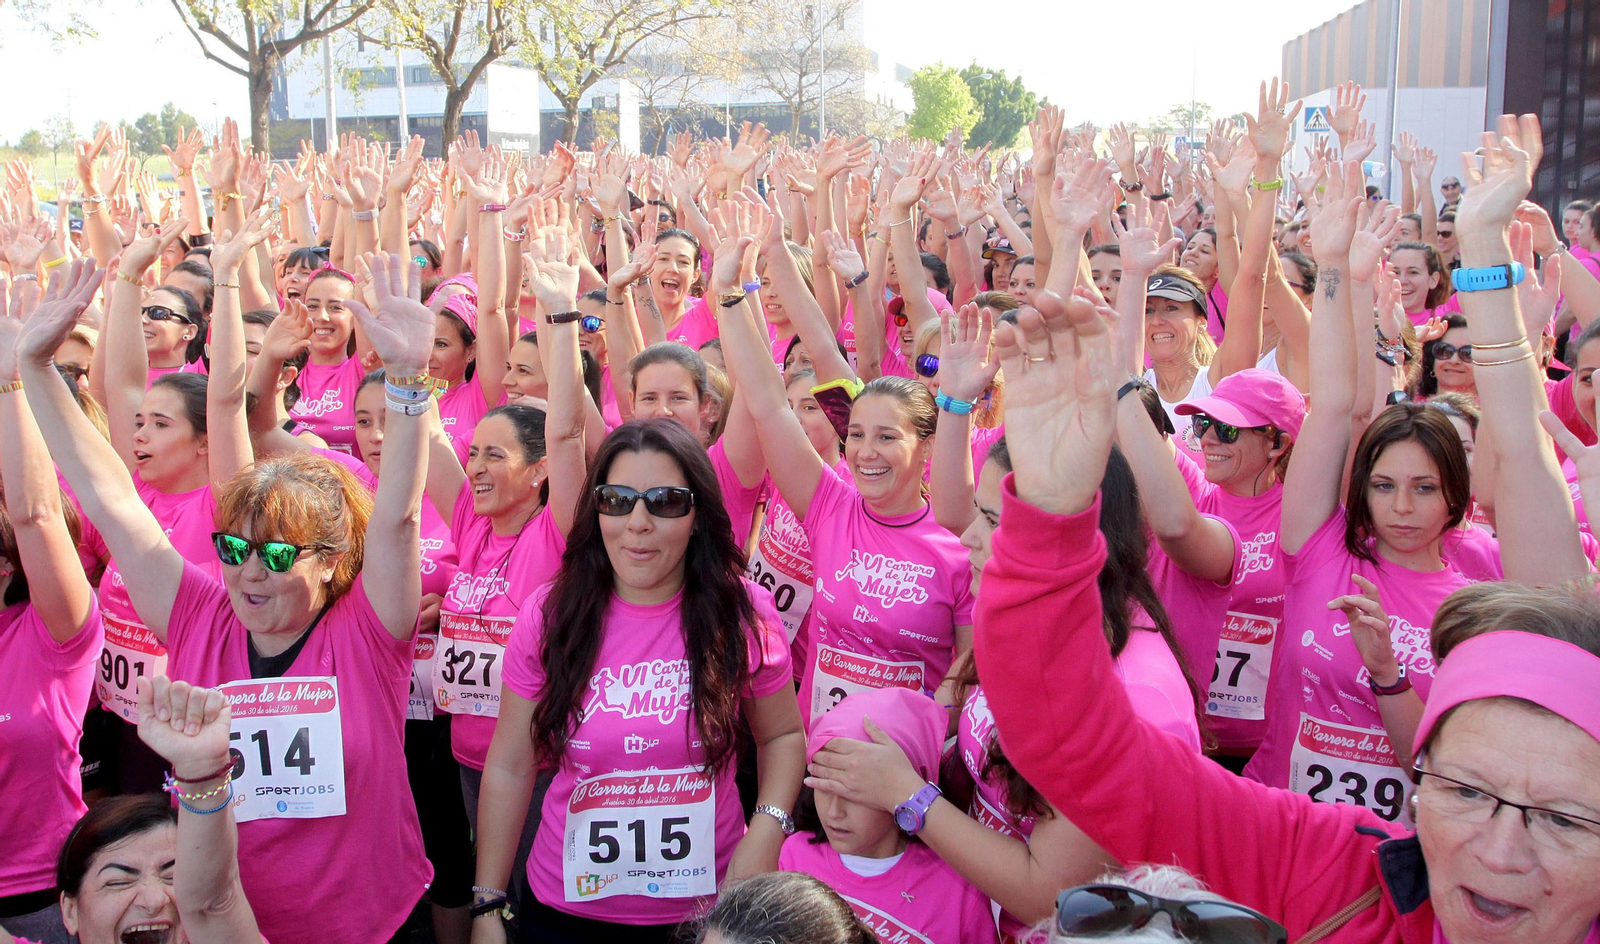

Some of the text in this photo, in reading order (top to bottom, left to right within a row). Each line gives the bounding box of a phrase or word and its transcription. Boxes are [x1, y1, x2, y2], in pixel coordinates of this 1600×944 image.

[778, 553, 788, 565] de
[787, 558, 797, 569] la
[864, 553, 933, 575] VI Carrera
[885, 569, 915, 583] de la
[861, 575, 926, 607] Mujer
[470, 619, 480, 631] de
[1228, 616, 1273, 639] la Mujer
[122, 626, 132, 639] de
[132, 628, 142, 641] la
[1398, 634, 1416, 646] de
[415, 642, 434, 656] ujer
[441, 646, 497, 687] 327
[833, 655, 868, 674] Carrera
[868, 664, 881, 678] de
[883, 666, 894, 680] la
[894, 668, 922, 686] Mujer
[622, 665, 647, 688] VI
[654, 675, 674, 690] de
[258, 684, 275, 702] de
[277, 684, 291, 701] la
[292, 684, 334, 705] Mujer
[1208, 691, 1258, 703] ORTJOBS
[1338, 690, 1365, 706] Carrefour
[248, 707, 257, 716] 30
[265, 704, 280, 713] abril
[280, 705, 299, 713] 2016
[1312, 726, 1356, 748] Carrera
[1357, 735, 1374, 752] de
[1375, 737, 1390, 753] la
[229, 727, 316, 782] 514
[1343, 750, 1352, 758] 30
[1352, 751, 1361, 759] de
[1376, 756, 1394, 765] 2016
[255, 784, 335, 796] SPORTJOBS
[588, 779, 637, 798] Carrera
[638, 776, 655, 793] de
[657, 776, 671, 793] la
[671, 774, 711, 796] Mujer
[1306, 763, 1405, 822] 239
[602, 797, 626, 806] Huelva
[626, 798, 636, 806] 30
[644, 795, 660, 804] abril
[660, 796, 677, 804] 2016
[588, 816, 692, 865] 515
[627, 866, 708, 879] SPORTJOBS
[875, 920, 890, 938] la
